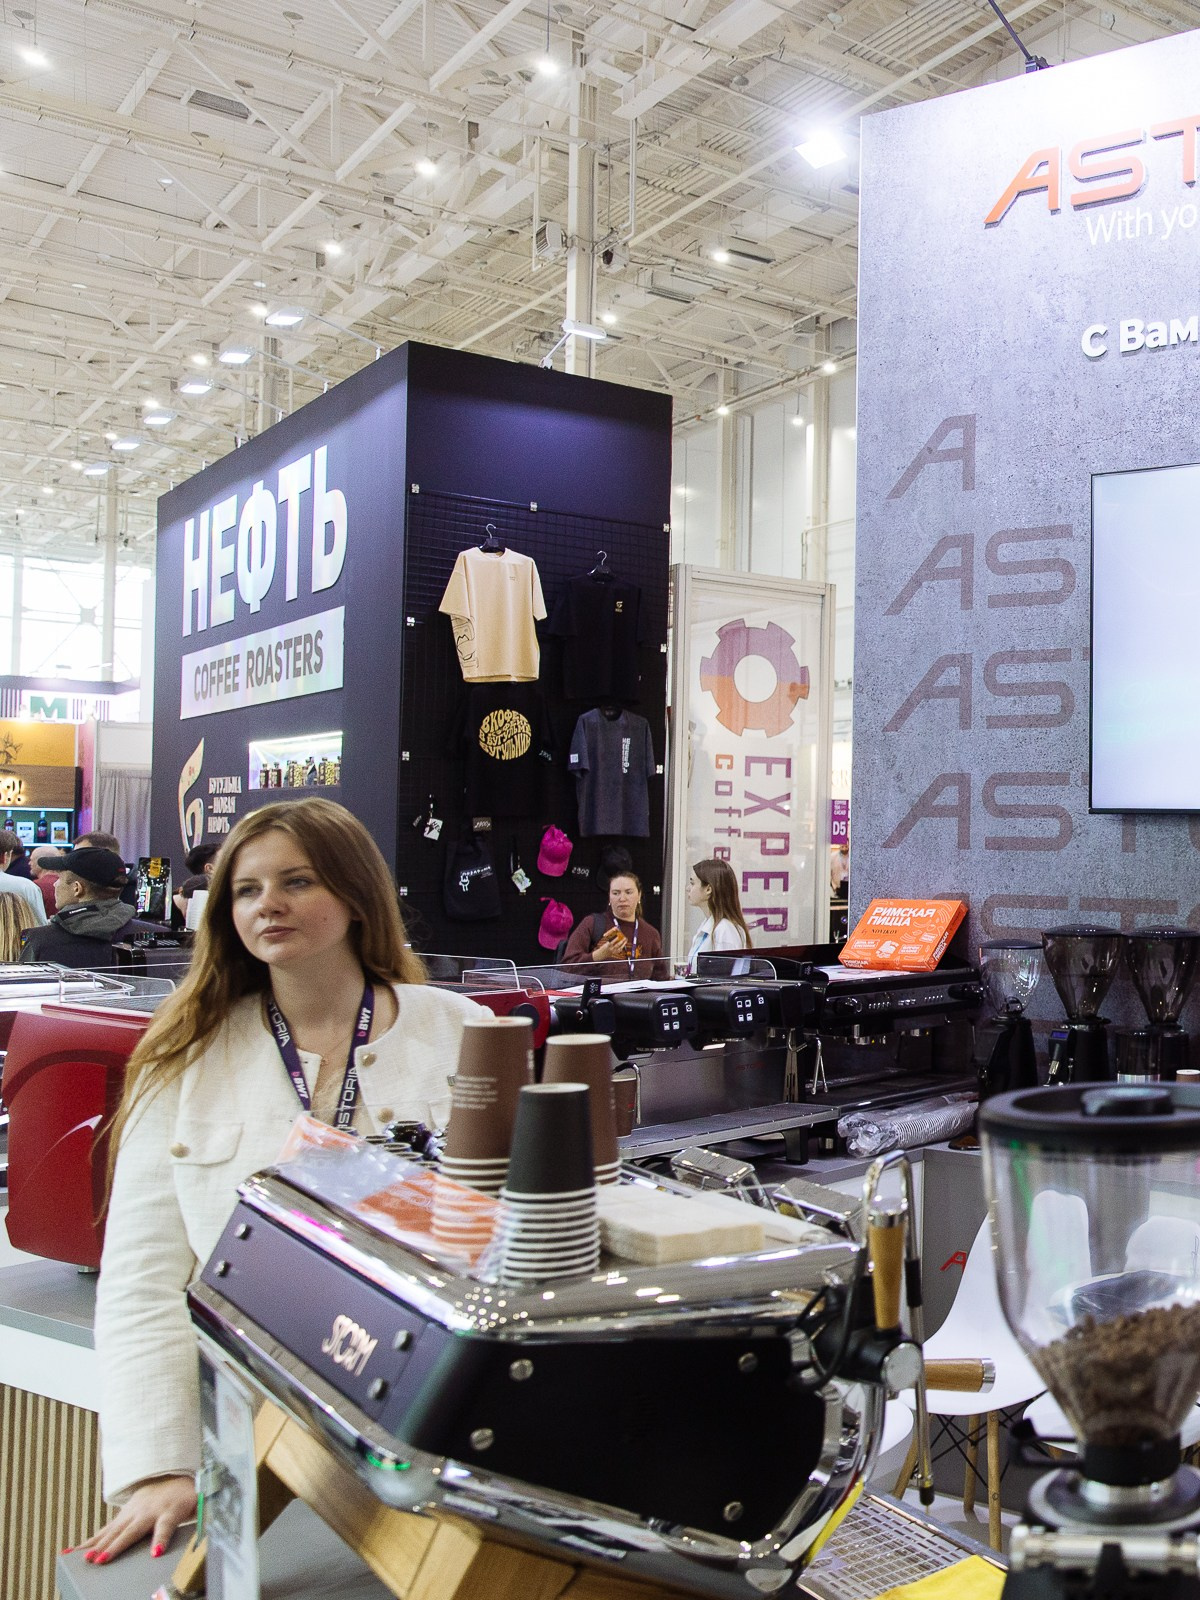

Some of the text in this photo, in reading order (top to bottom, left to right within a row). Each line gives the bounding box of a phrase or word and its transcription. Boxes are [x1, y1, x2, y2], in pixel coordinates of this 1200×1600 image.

[1085, 208, 1153, 246] With
[887, 413, 977, 500] A
[181, 445, 348, 637] НЕФТЬ
[882, 523, 1077, 617] AS
[193, 630, 324, 701] COFFEE ROASTERS
[881, 648, 1090, 733] AS
[207, 816, 230, 834] НЕФТЬ
[713, 754, 741, 863] coffe
[832, 821, 847, 836] D5
[867, 915, 912, 926] ПИЦЦА
[872, 907, 936, 918] РИМСКАЯ
[358, 1007, 372, 1031] BWT
[293, 1077, 309, 1099] BWT
